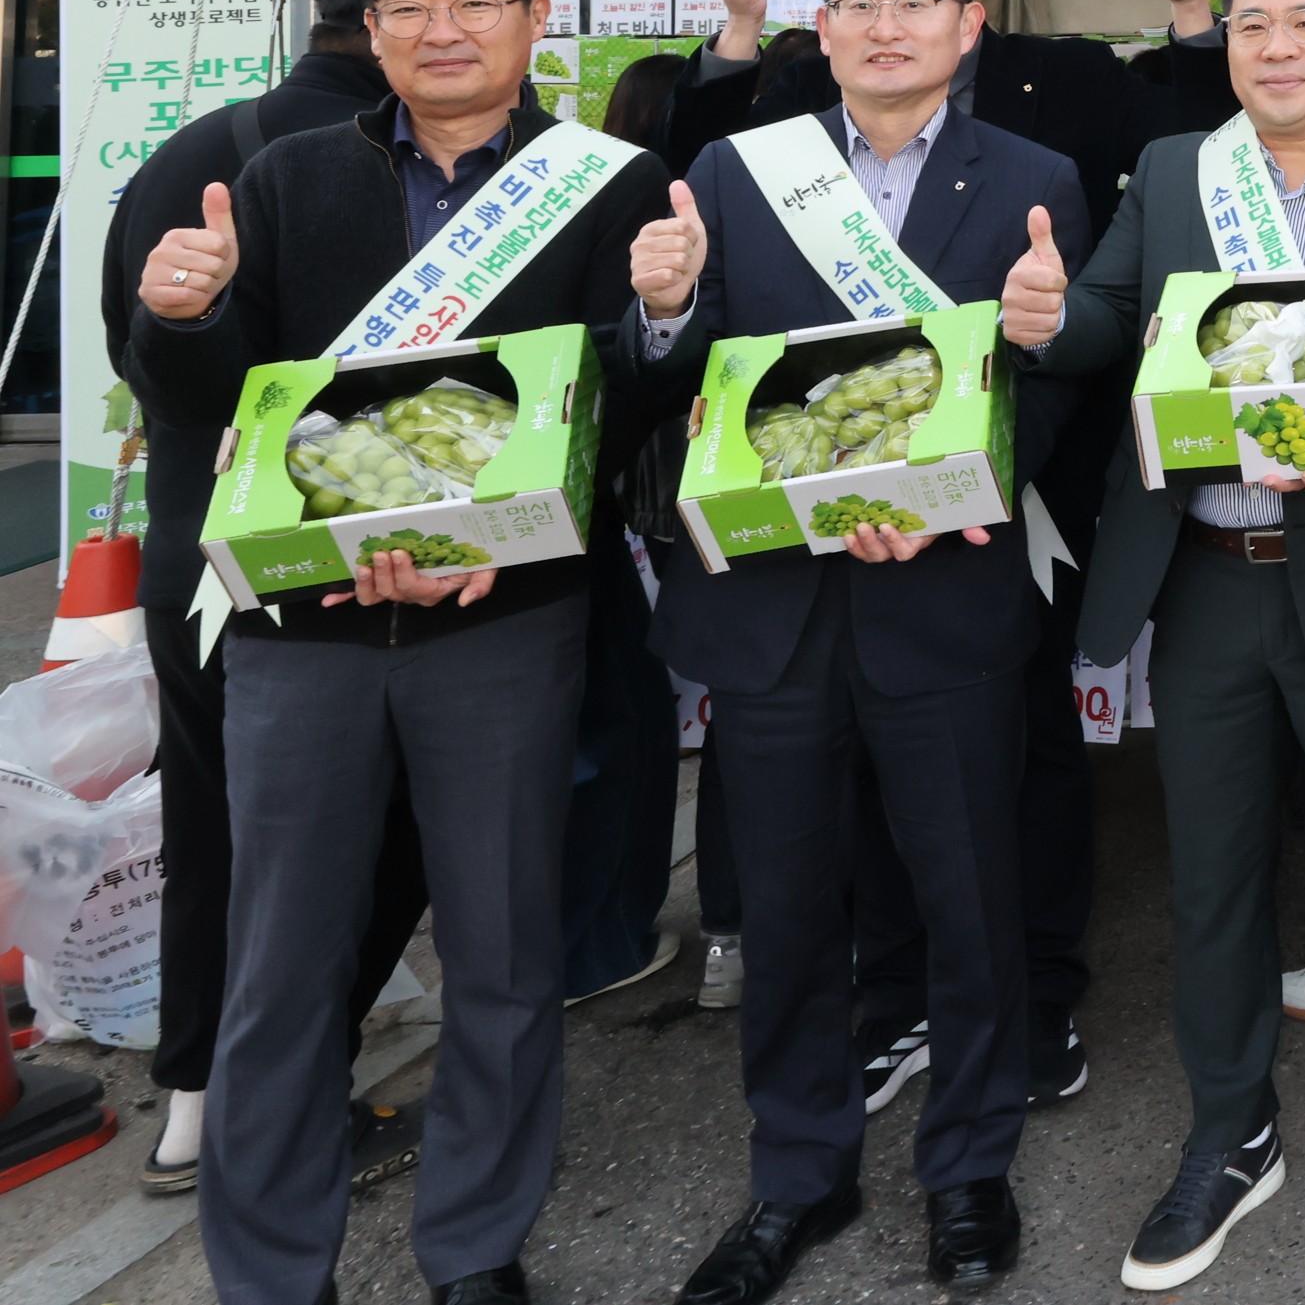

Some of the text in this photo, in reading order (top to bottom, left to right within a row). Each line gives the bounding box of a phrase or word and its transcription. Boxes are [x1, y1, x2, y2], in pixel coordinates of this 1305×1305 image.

[447, 156, 549, 257] 소비촉진
[783, 171, 838, 210] 반딧불
[959, 467, 981, 492] 샤인
[530, 501, 554, 525] 샤인
